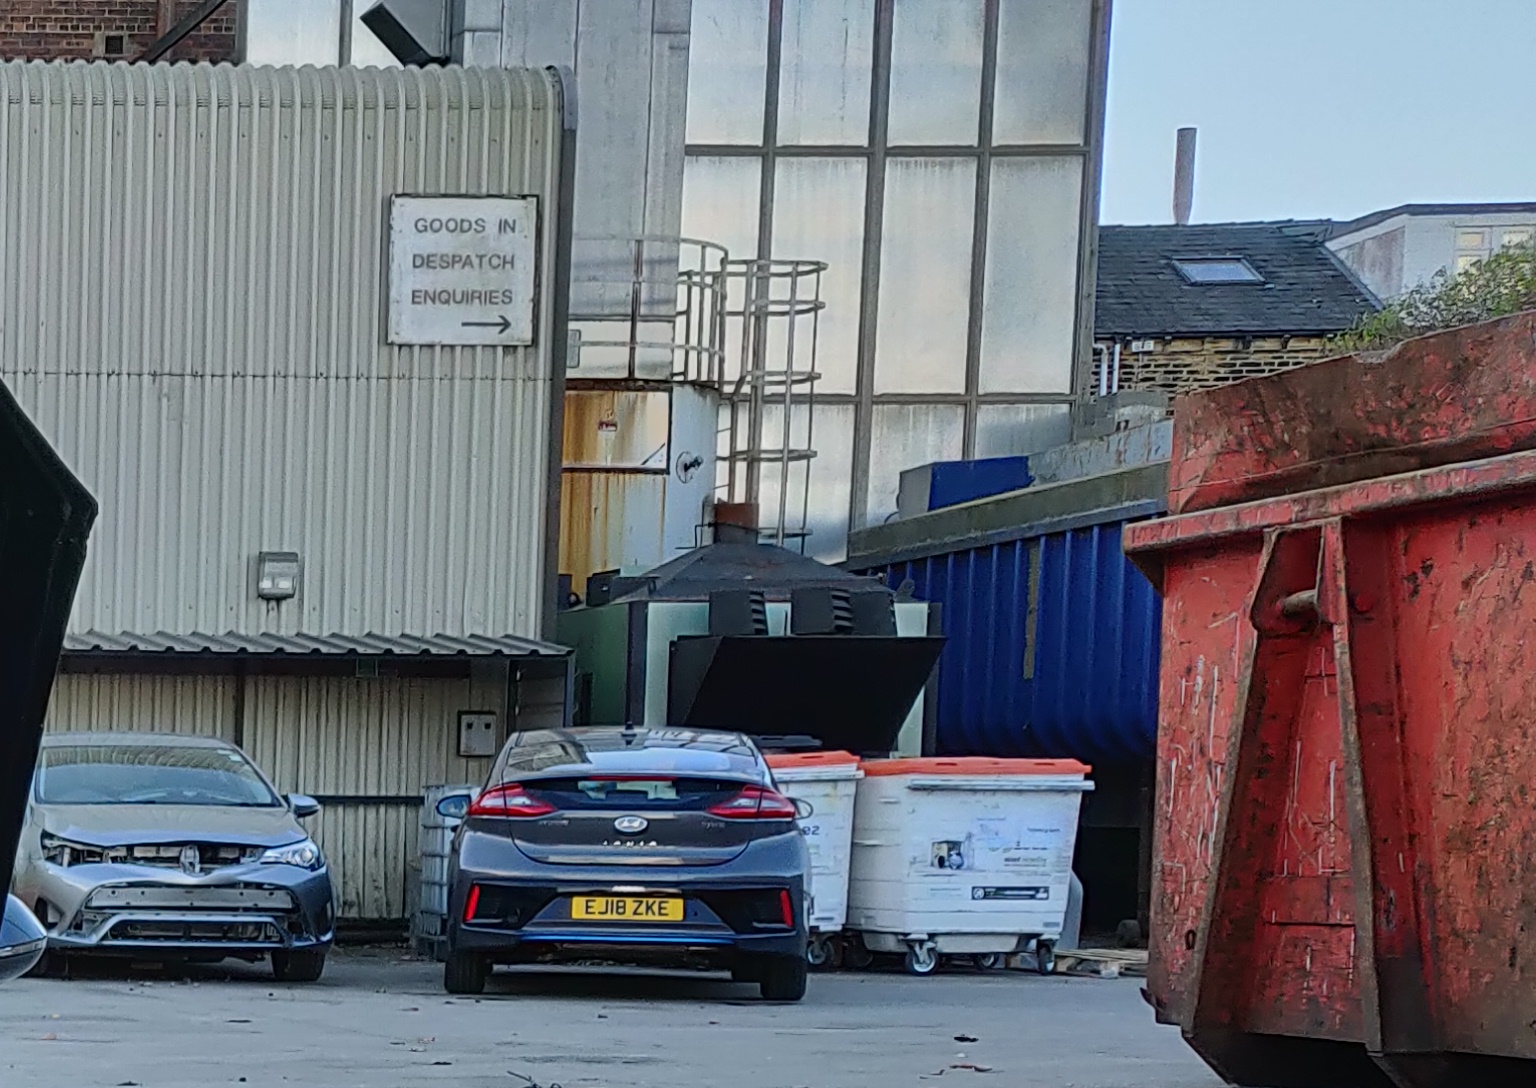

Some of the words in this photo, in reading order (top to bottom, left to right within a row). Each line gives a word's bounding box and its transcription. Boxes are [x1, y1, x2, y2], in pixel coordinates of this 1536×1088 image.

[414, 218, 487, 233] GOODS
[498, 218, 516, 234] IN
[412, 253, 515, 270] DESPATCH
[411, 289, 513, 306] ENQUIRIES
[584, 900, 626, 915] EJ18
[632, 901, 670, 916] ZKE
